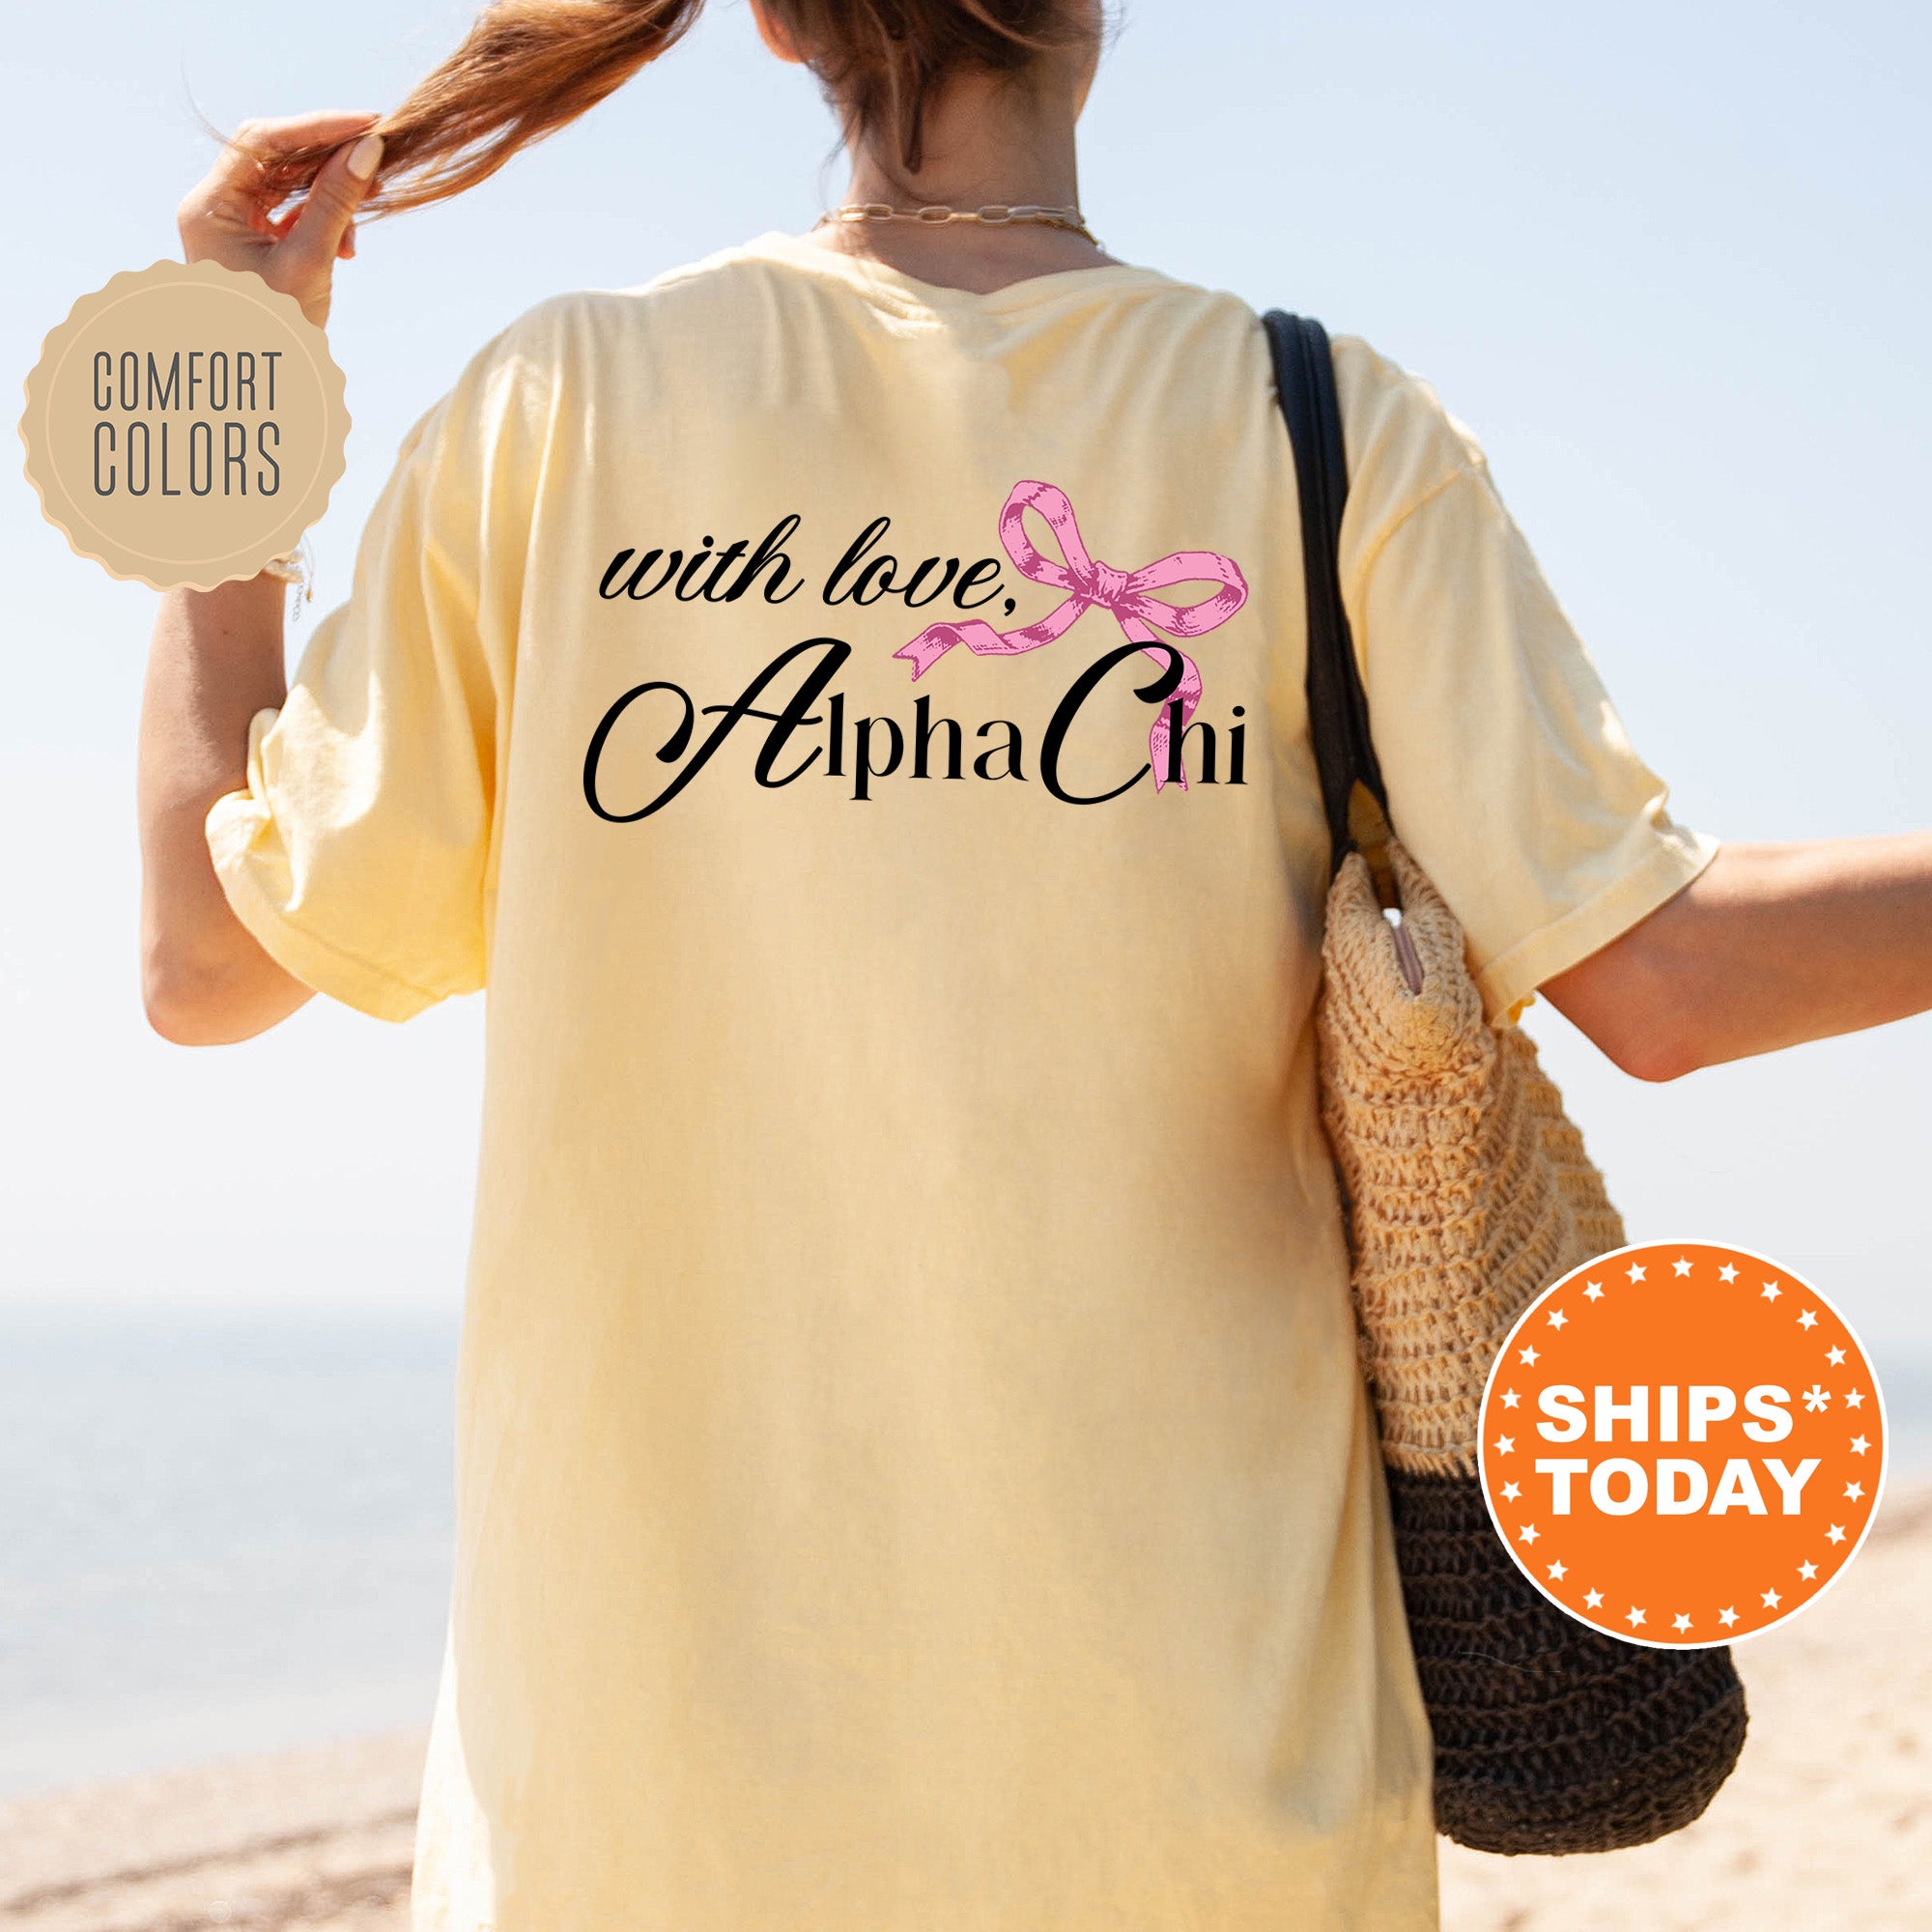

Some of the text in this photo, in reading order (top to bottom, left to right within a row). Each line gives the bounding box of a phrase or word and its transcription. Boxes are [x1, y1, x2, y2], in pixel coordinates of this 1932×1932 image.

[599, 514, 1017, 617] with love,
[582, 637, 1247, 824] Alpha Chi
